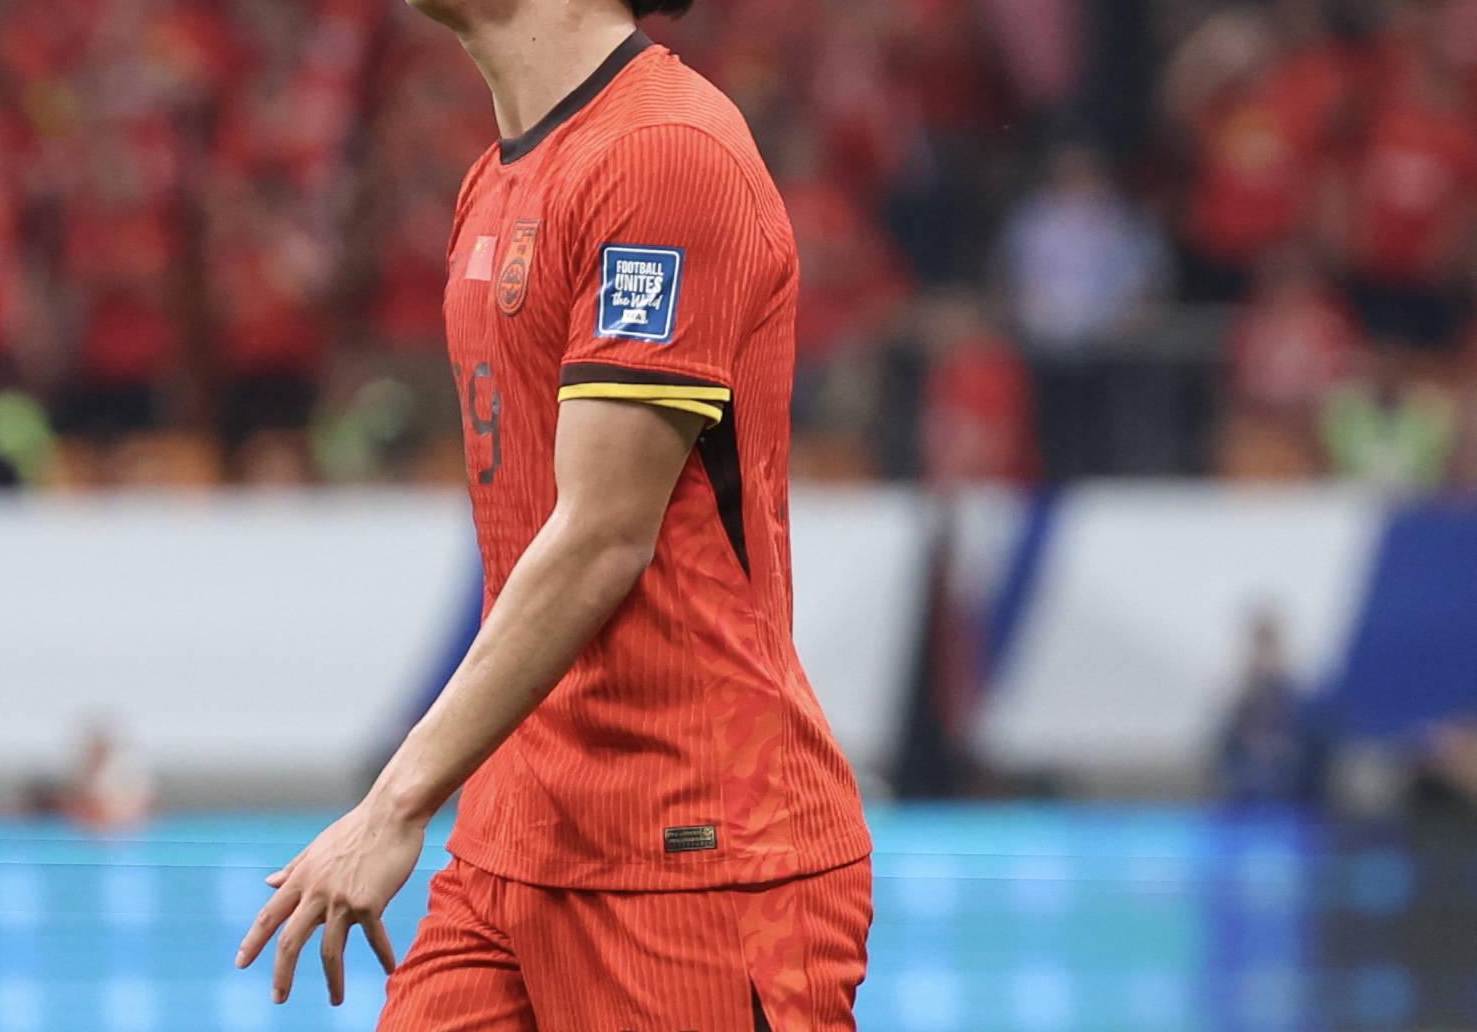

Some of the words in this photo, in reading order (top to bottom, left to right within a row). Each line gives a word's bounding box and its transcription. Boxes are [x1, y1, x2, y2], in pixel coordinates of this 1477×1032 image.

[616, 260, 664, 276] FOOTBALL
[615, 274, 664, 294] UNITES
[611, 291, 630, 307] the
[454, 361, 502, 485] 9
